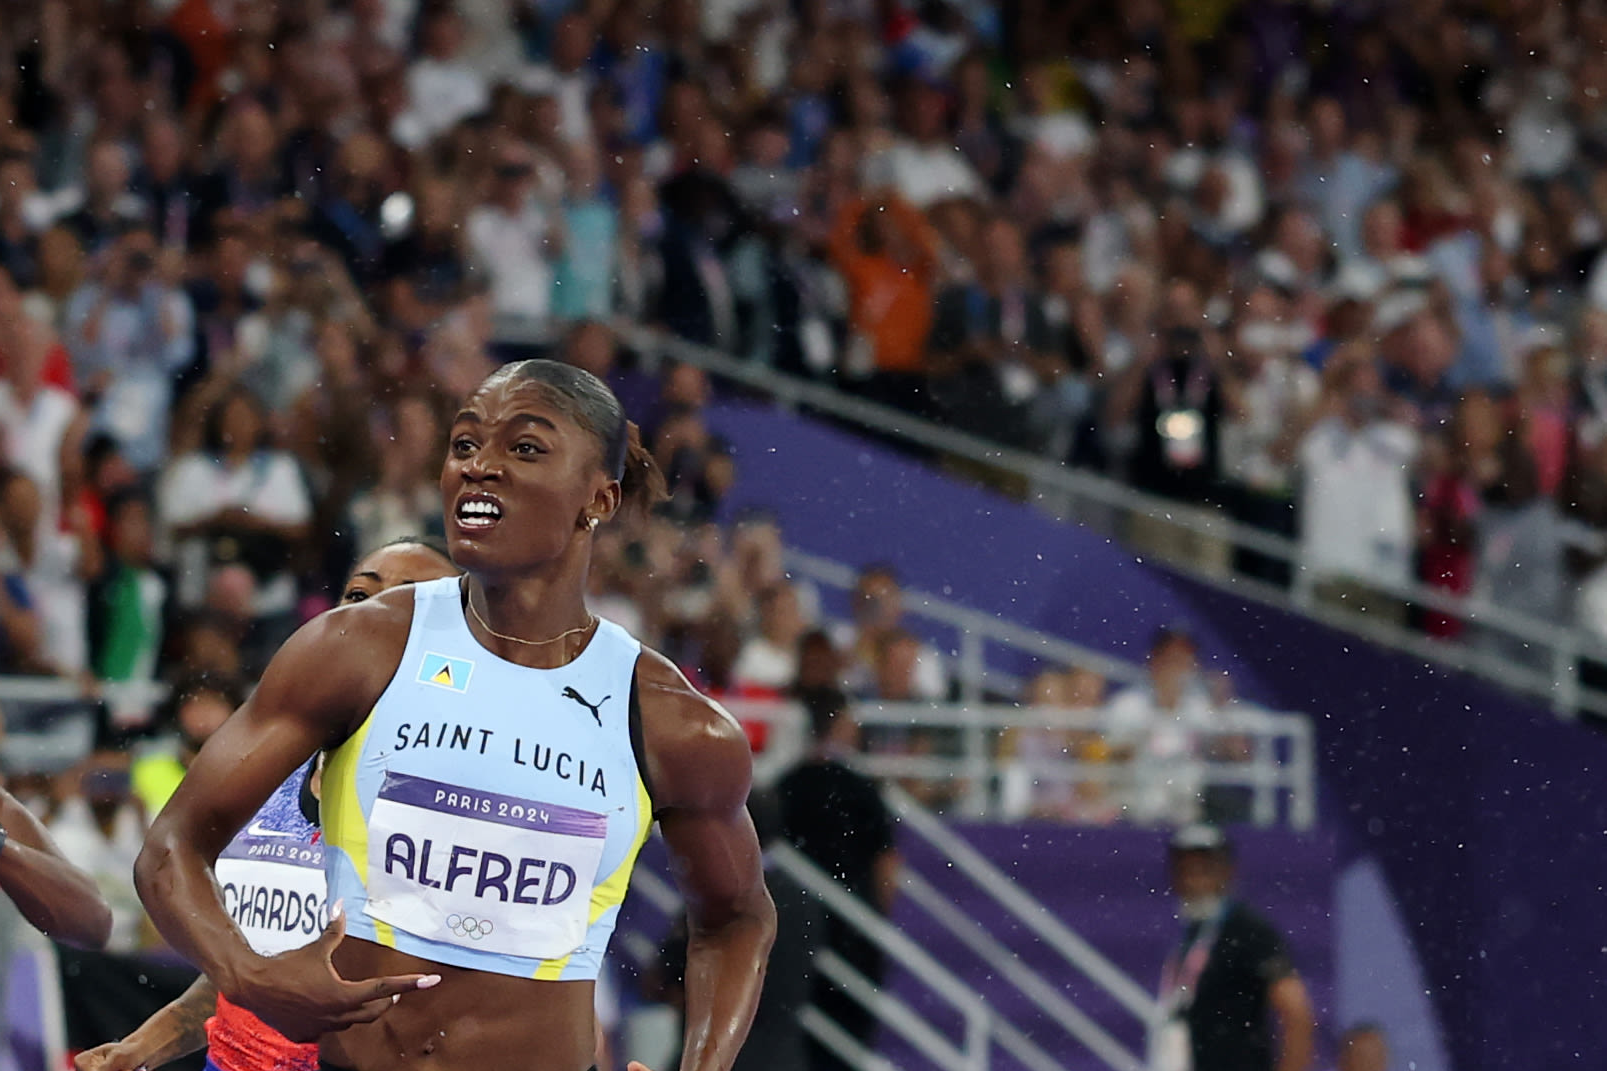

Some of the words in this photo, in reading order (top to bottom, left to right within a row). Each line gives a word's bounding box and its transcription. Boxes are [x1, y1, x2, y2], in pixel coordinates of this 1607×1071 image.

[394, 722, 494, 755] SAINT
[514, 738, 607, 797] LUCIA
[435, 789, 491, 814] PARIS
[498, 802, 550, 824] 2024
[248, 843, 285, 857] PARIS
[384, 832, 576, 906] ALFRED
